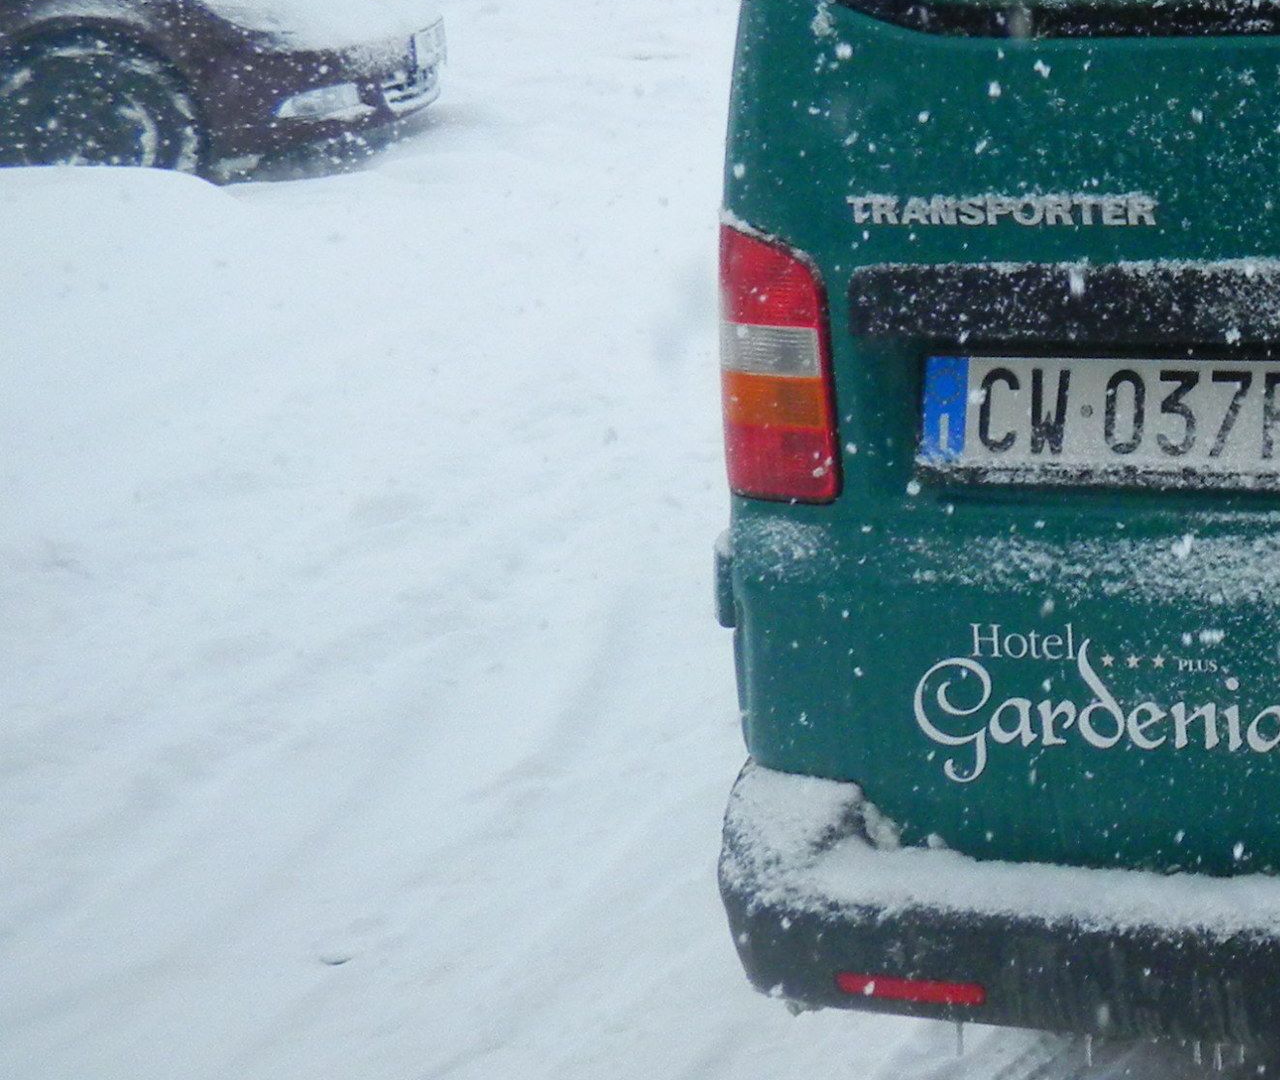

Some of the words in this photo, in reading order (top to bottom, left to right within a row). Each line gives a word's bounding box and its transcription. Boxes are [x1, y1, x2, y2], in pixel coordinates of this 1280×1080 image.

[846, 192, 1159, 226] TRANSPORTER
[978, 366, 1071, 456] CW
[969, 622, 1077, 661] Hotel
[1178, 659, 1219, 673] PLUS
